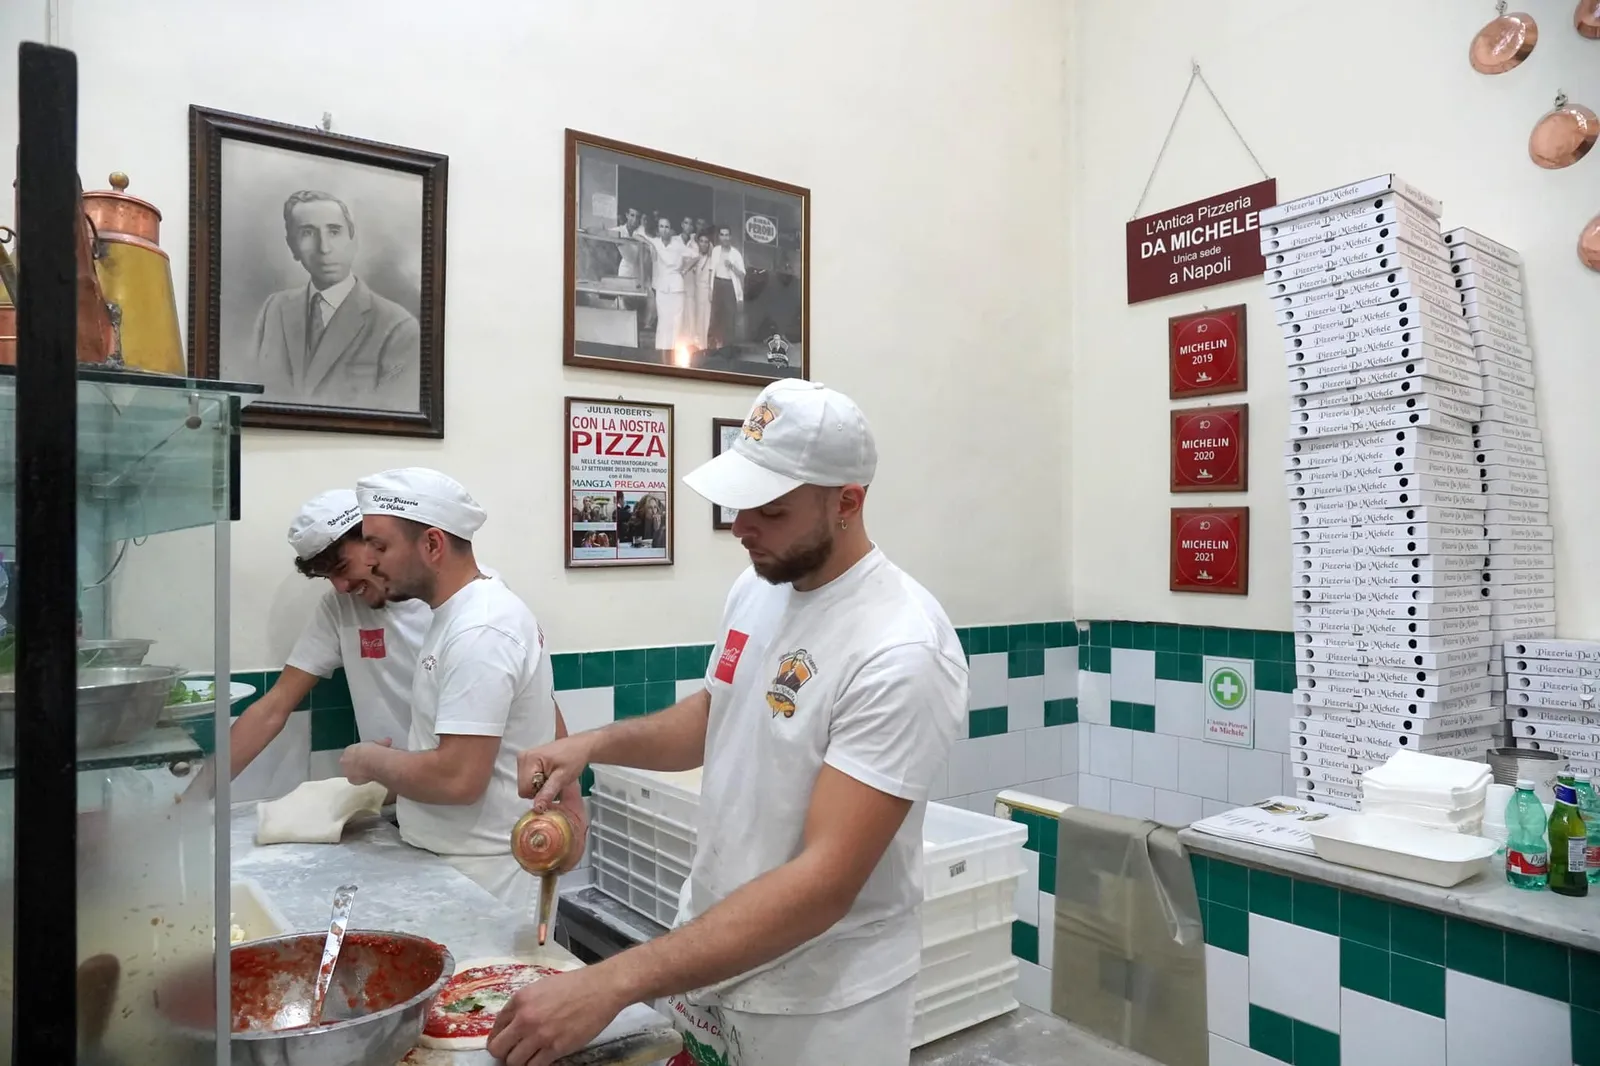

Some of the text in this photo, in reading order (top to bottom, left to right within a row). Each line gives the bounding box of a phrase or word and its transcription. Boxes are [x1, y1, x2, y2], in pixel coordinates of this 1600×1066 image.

[1286, 187, 1359, 213] Pizzeria Da Michele
[1147, 197, 1251, 235] L'Antica Pizzeria
[1291, 207, 1365, 232] Pizzeria Da Michele
[1141, 212, 1258, 258] DA MICHELE
[1297, 236, 1371, 259] Pizzeria Da Michele
[1174, 246, 1221, 264] Unica sede
[1170, 256, 1231, 284] a Napoli
[1298, 266, 1372, 289] Pizzeria Da Michele
[1307, 296, 1381, 317] Pizzeria Da Michele
[1313, 310, 1390, 331] Pizzeria Da Michele
[1180, 339, 1227, 354] MICHELIN
[1317, 339, 1393, 359] Pizzeria Da Michele
[1192, 354, 1213, 365] 2019
[1321, 370, 1397, 389] Pizzeria Da Michele
[1320, 403, 1396, 419] Pizzeria Da Michele
[573, 416, 665, 433] CON LA NOSTRA
[1317, 418, 1396, 434] Pizzeria Da Michele
[573, 431, 665, 457] PIZZA
[1182, 438, 1228, 448] MICHELIN
[1194, 452, 1214, 460] 2020
[1309, 451, 1382, 466] Pizzeria Da Michele
[1313, 481, 1386, 495] Pizzeria Da Michele
[1315, 497, 1387, 510] Pizzeria Da Michele
[1318, 529, 1394, 540] Pizzeria Da Michele
[1182, 540, 1228, 549] MICHELIN
[1195, 553, 1214, 561] 2021
[1321, 561, 1398, 570] Pizzeria Da Michele
[1320, 576, 1398, 585] Pizzeria Da Michele
[1320, 592, 1398, 601] Pizzeria Da Michele
[1320, 608, 1395, 617] Pizzeria Da Michele
[1325, 638, 1400, 649] Pizzeria Da Michele
[1327, 654, 1406, 665] Pizzeria Da Michele
[1535, 648, 1590, 660] Pizzeria Da
[1328, 669, 1408, 682] Pizzeria Da Michele
[1537, 664, 1592, 677] Pizzeria Da
[1540, 681, 1596, 695] Pizzeria Da
[1324, 699, 1400, 713] Pizzeria Da Michele
[1539, 697, 1595, 710] Pizzeria Da
[1324, 714, 1395, 729] Pizzeria Da Michele
[1537, 711, 1594, 725] Pizzeria Da
[1320, 728, 1392, 747] Pizzeria Da Michele
[1546, 730, 1585, 741] Pizzeria
[1319, 743, 1347, 754] Pizzeria
[1349, 748, 1362, 756] Da
[1550, 746, 1589, 758] Pizzeria
[1320, 759, 1364, 773] Pizzeria Da
[1323, 774, 1351, 785] Pizzeria
[1328, 789, 1356, 800] Pizzeria
[697, 1019, 708, 1031] LA
